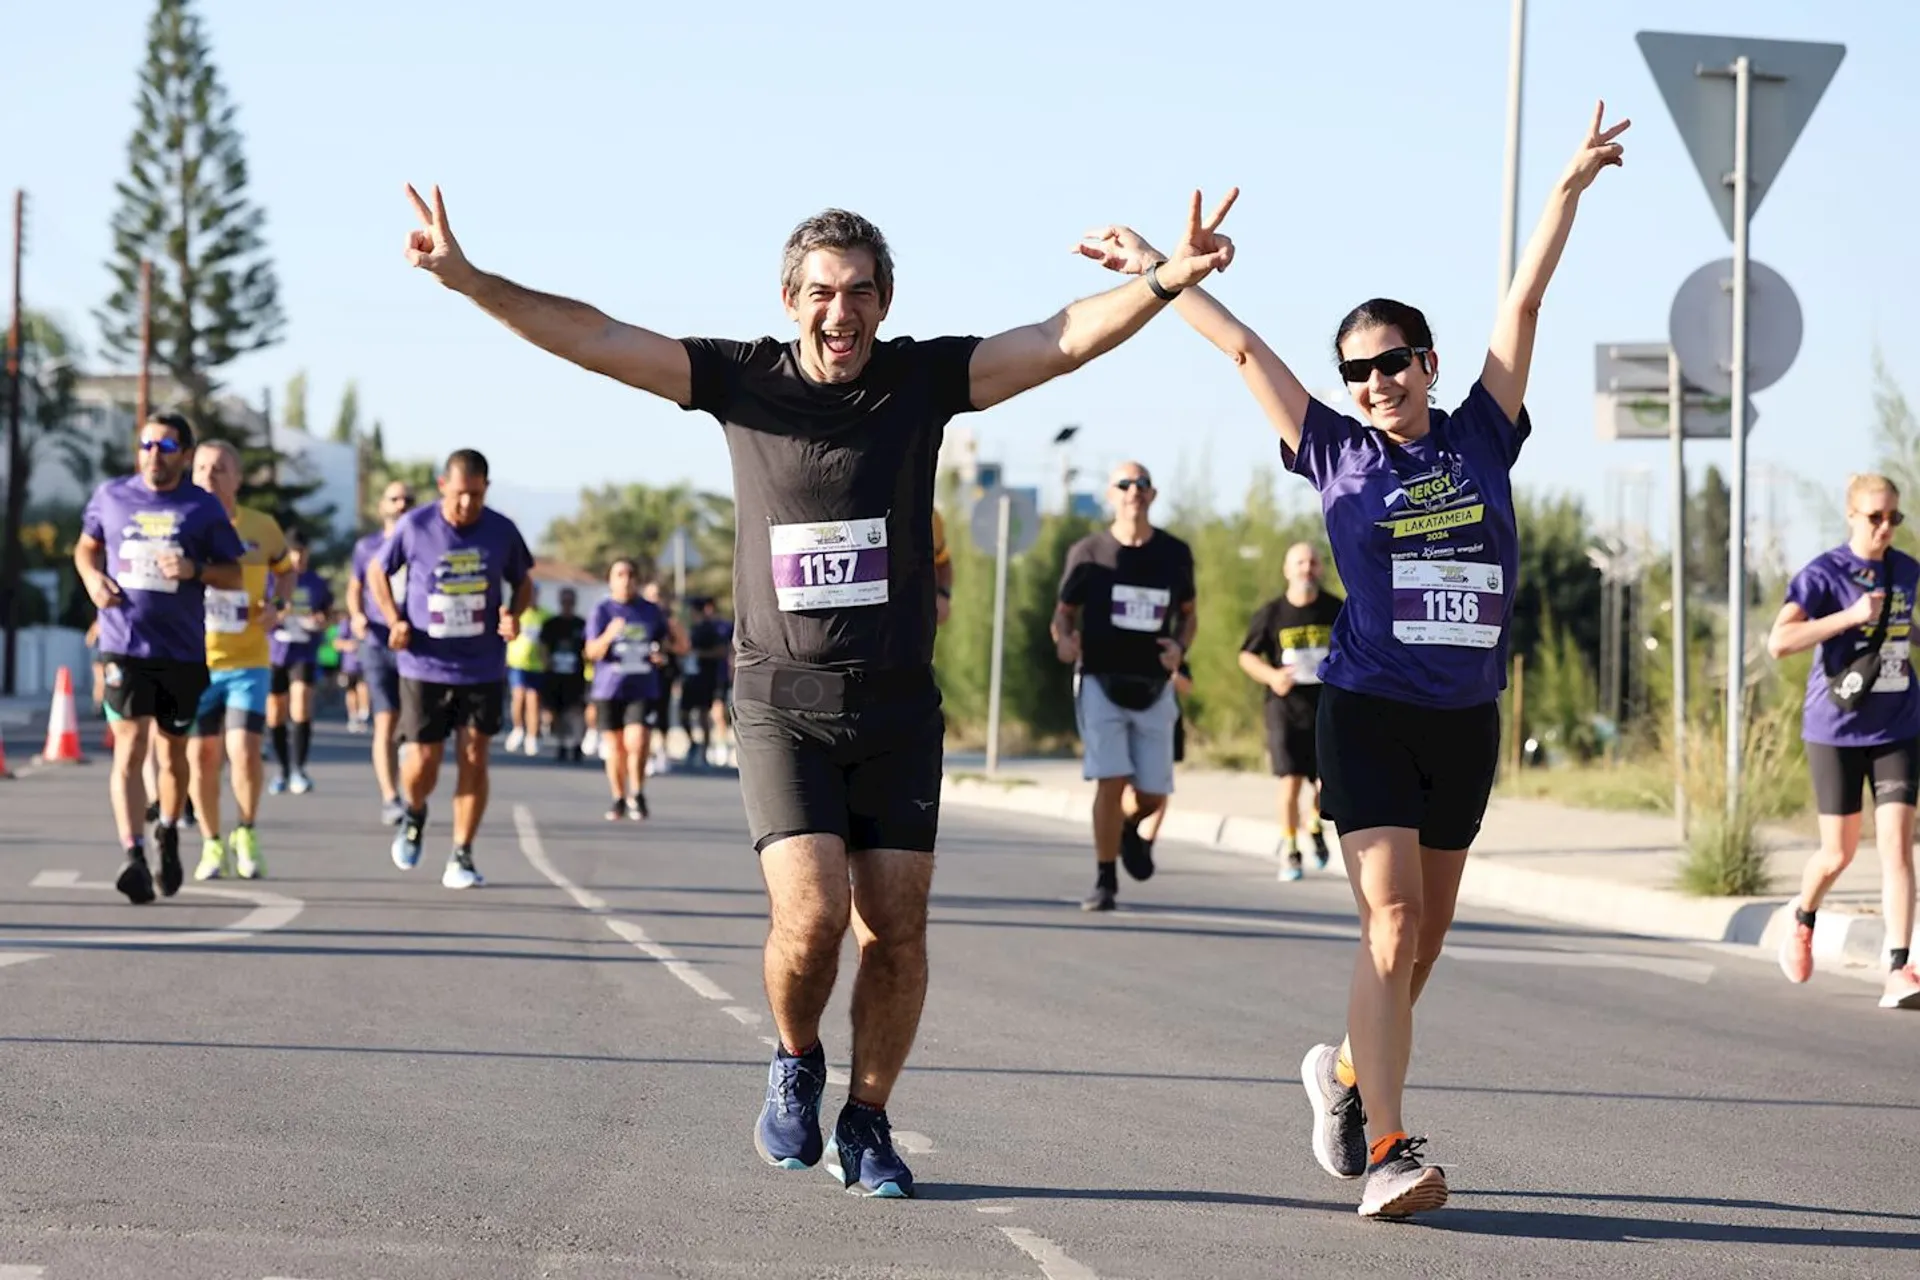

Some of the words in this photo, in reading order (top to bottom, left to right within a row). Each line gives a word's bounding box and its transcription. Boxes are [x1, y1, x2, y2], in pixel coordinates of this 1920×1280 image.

[1405, 510, 1473, 532] LAKATAMEIA
[1426, 531, 1449, 542] 2024
[800, 552, 858, 586] 1137
[1423, 591, 1479, 623] 1136
